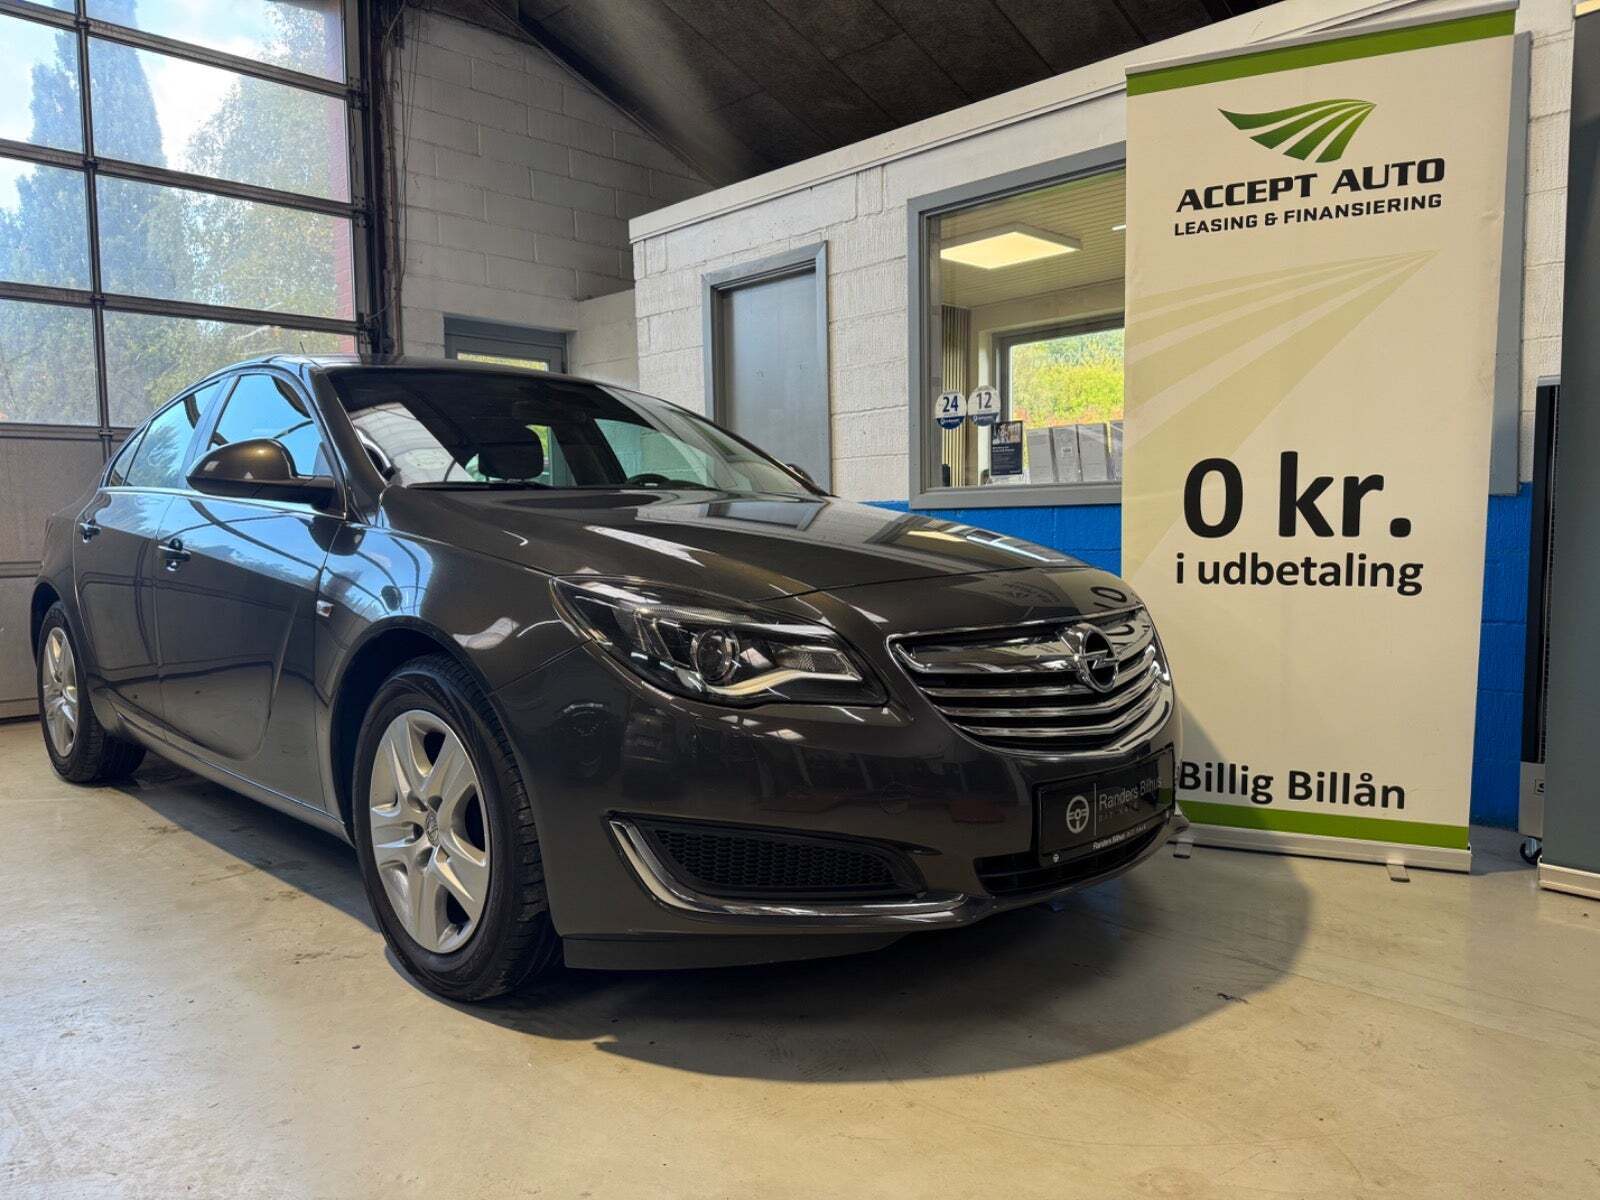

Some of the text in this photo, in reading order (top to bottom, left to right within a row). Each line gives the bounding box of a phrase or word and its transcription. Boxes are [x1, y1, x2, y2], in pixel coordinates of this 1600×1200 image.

[1177, 157, 1445, 213] ACCEPT AUTO
[1174, 194, 1442, 236] LEASING & FINANSIERING
[943, 391, 959, 412] 24
[977, 391, 992, 409] 12
[1183, 450, 1412, 539] 0 kr.
[1176, 552, 1424, 597] i udbetaling
[1099, 786, 1139, 811] Randers
[1178, 761, 1406, 809] Billig Billån
